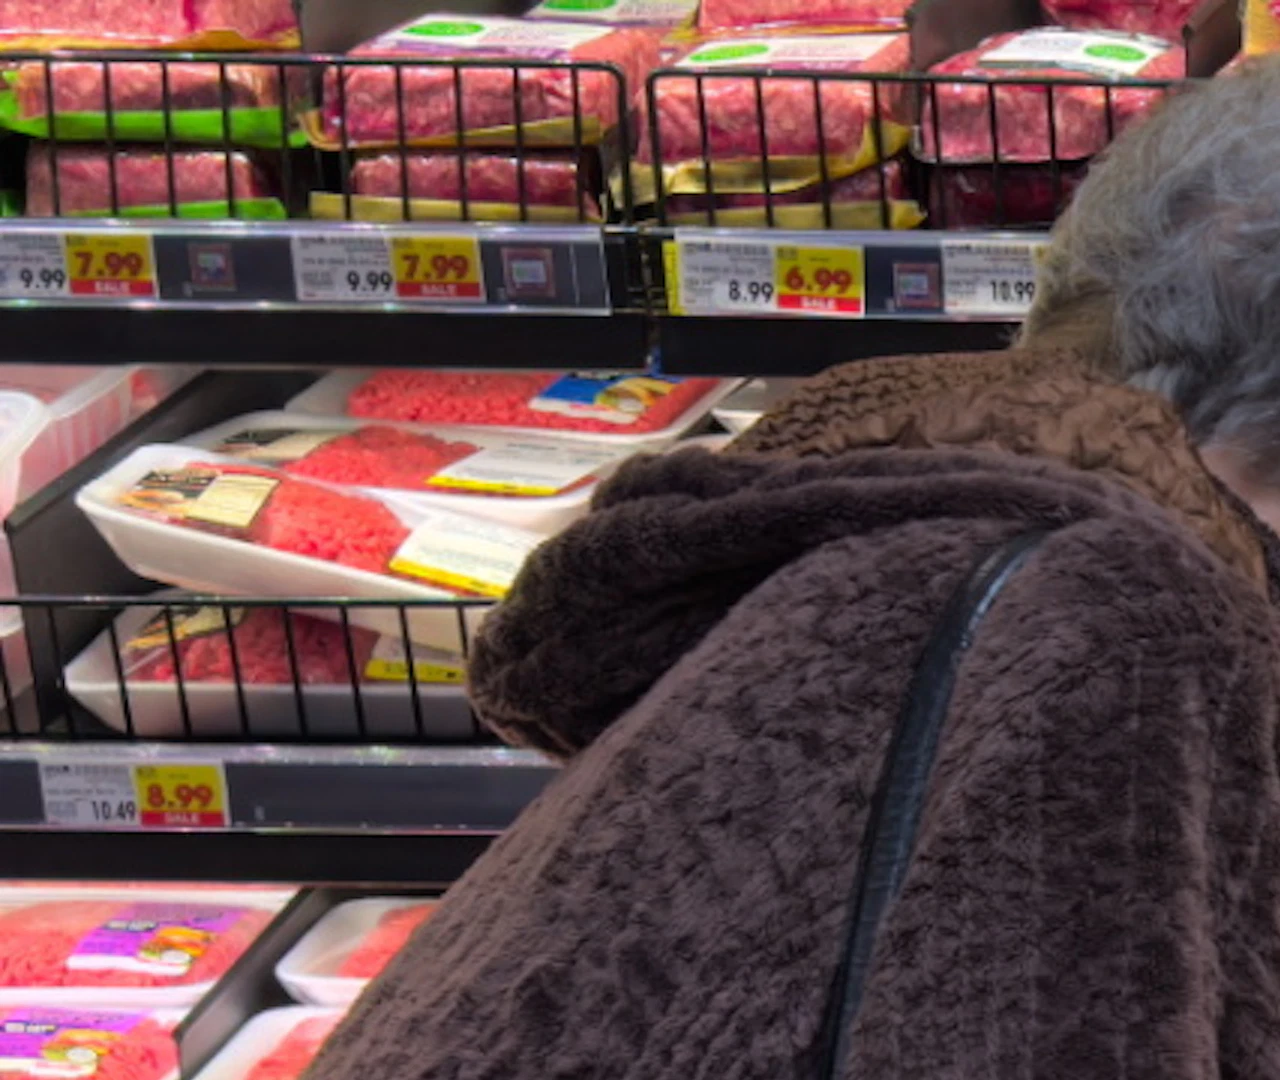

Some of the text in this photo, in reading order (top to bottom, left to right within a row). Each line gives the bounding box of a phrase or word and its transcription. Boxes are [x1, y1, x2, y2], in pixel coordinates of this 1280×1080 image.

[74, 252, 144, 277] 7.99
[402, 255, 469, 280] 7.99
[20, 269, 65, 289] 9.99
[346, 271, 393, 292] 9.99
[729, 280, 774, 303] 8.99
[785, 266, 853, 295] 6.99
[147, 784, 213, 809] 8.99
